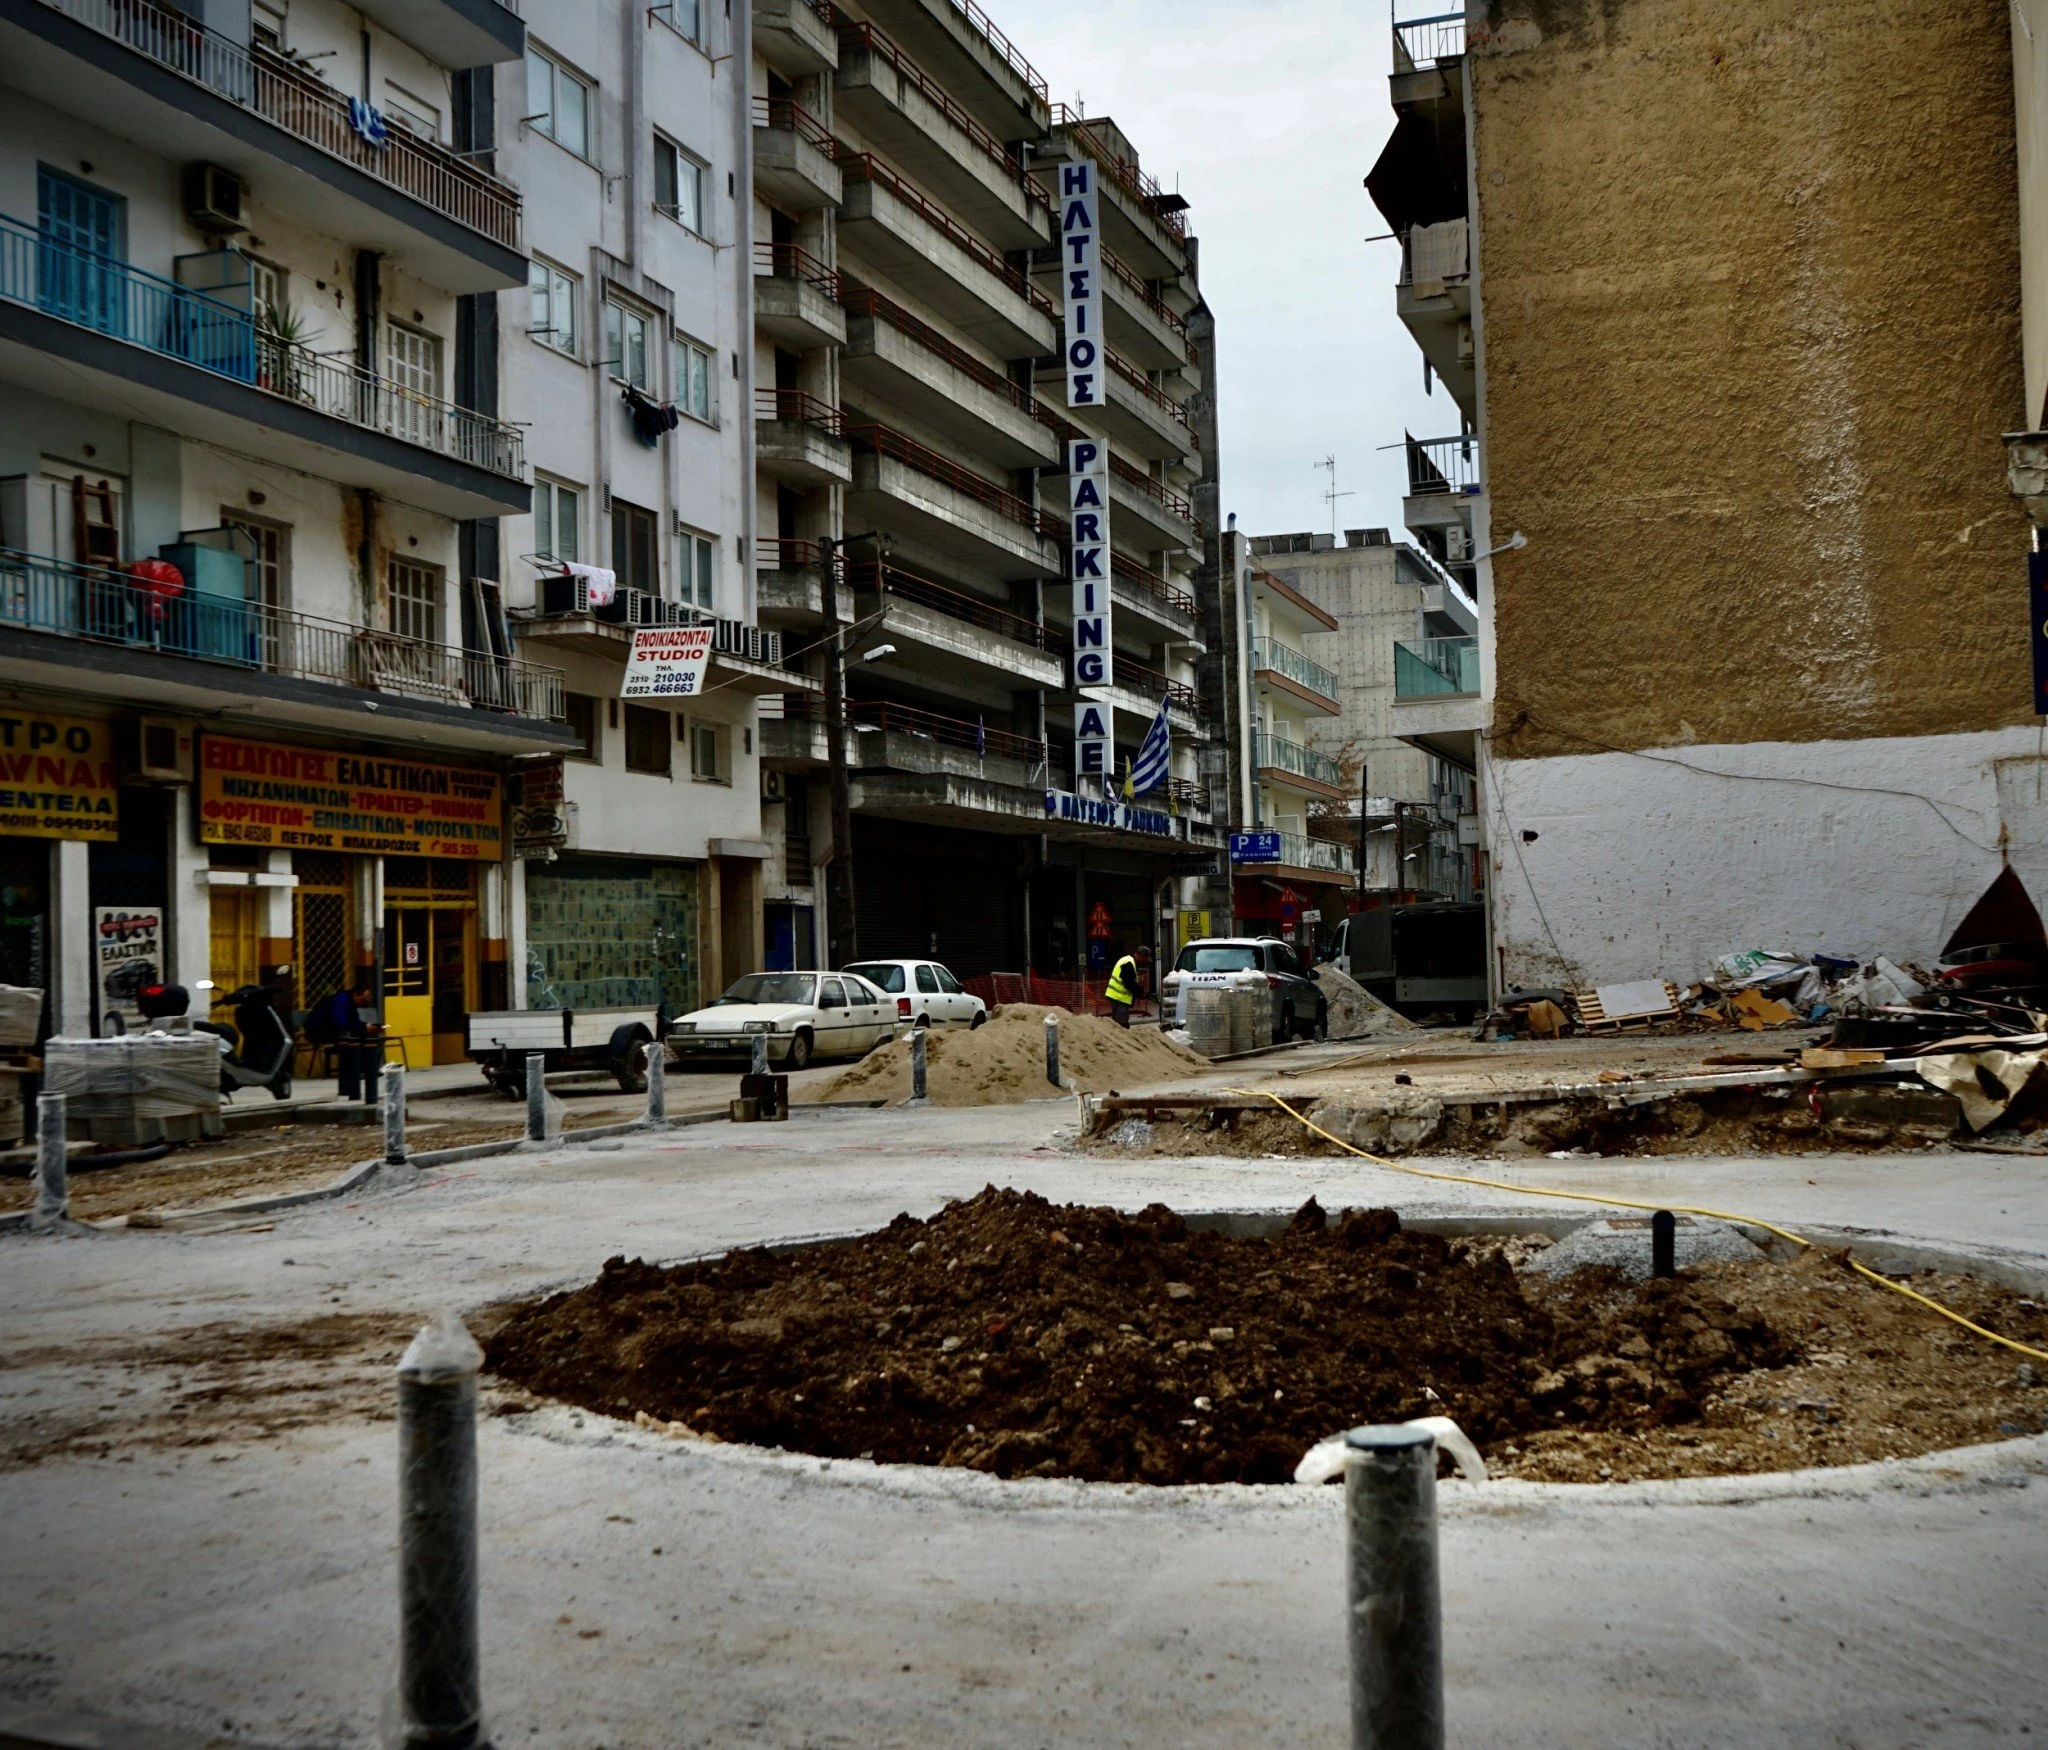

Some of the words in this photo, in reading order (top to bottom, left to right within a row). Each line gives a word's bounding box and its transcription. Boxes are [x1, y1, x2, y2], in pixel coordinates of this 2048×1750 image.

[1063, 165, 1096, 404] ΗΛΤΣΙΟΣ
[1074, 443, 1104, 683] PARKING
[637, 649, 704, 661] STUDIO
[654, 672, 696, 684] 210030
[337, 757, 449, 795] ΕΛΑΣΤΙΚΩΝ
[1124, 807, 1171, 836] PARKING
[280, 830, 333, 847] ΠΕΤΡΟΣ
[1258, 835, 1272, 846] 24
